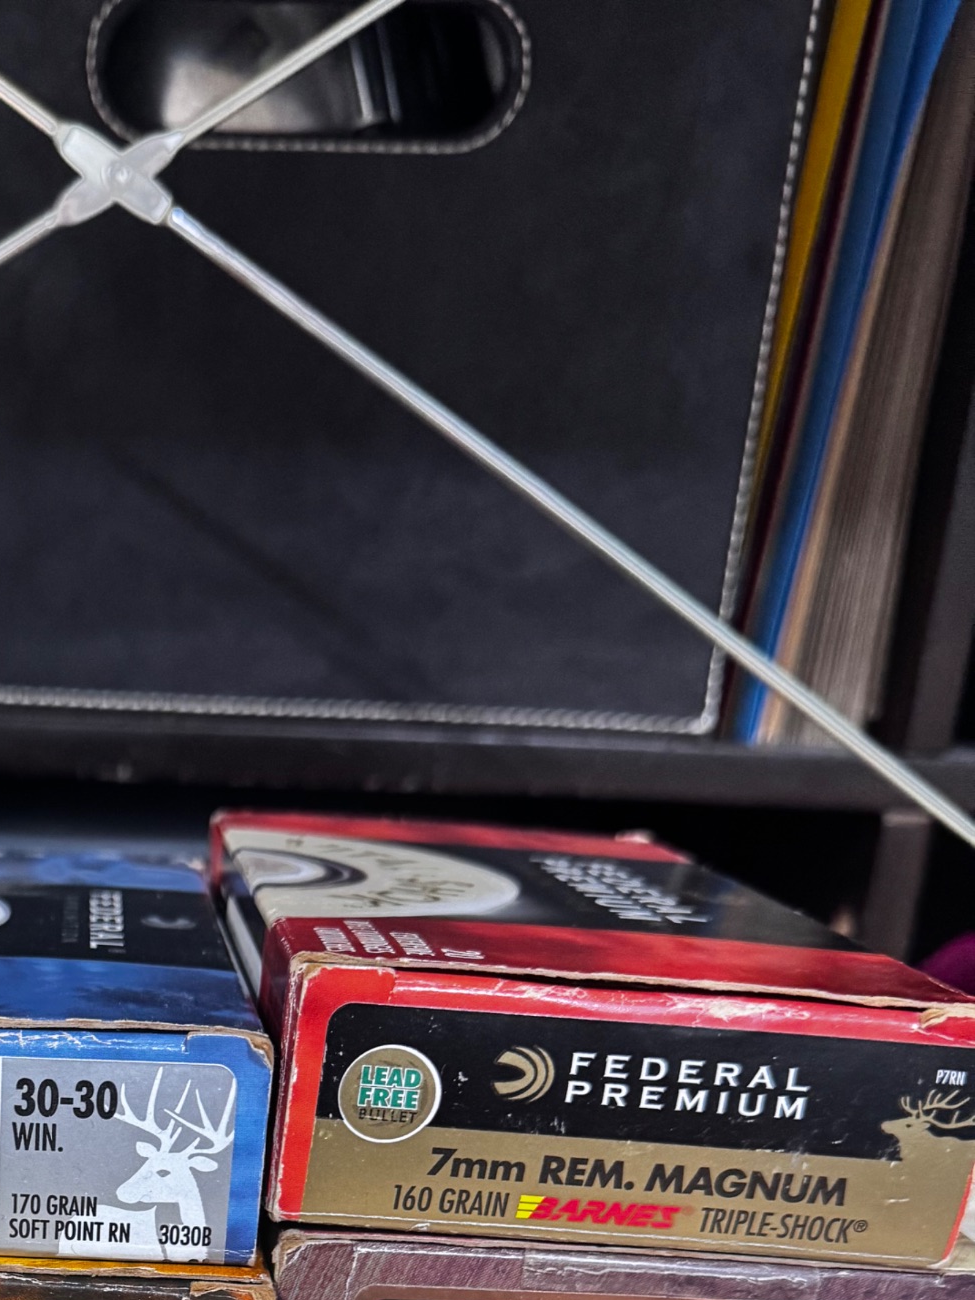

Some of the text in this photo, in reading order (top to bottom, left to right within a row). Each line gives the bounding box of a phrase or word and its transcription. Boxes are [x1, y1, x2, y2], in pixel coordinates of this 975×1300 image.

[360, 1064, 423, 1089] LEAD
[569, 1052, 812, 1093] FEDERAL
[935, 1068, 967, 1086] P7RN
[13, 1078, 119, 1120] 30-30
[356, 1085, 421, 1111] FREE
[564, 1080, 808, 1121] PREMIUM
[358, 1108, 418, 1125] BULLET
[12, 1121, 64, 1152] WIN.
[427, 1147, 848, 1206] 7mm REM. MAGNUM
[11, 1193, 98, 1217] 170 GRAIN
[393, 1184, 434, 1212] 160
[439, 1187, 510, 1218] GRAIN
[516, 1194, 684, 1229] BARNES
[9, 1218, 131, 1244] SOFT POINT RN
[158, 1224, 213, 1247] 3030B
